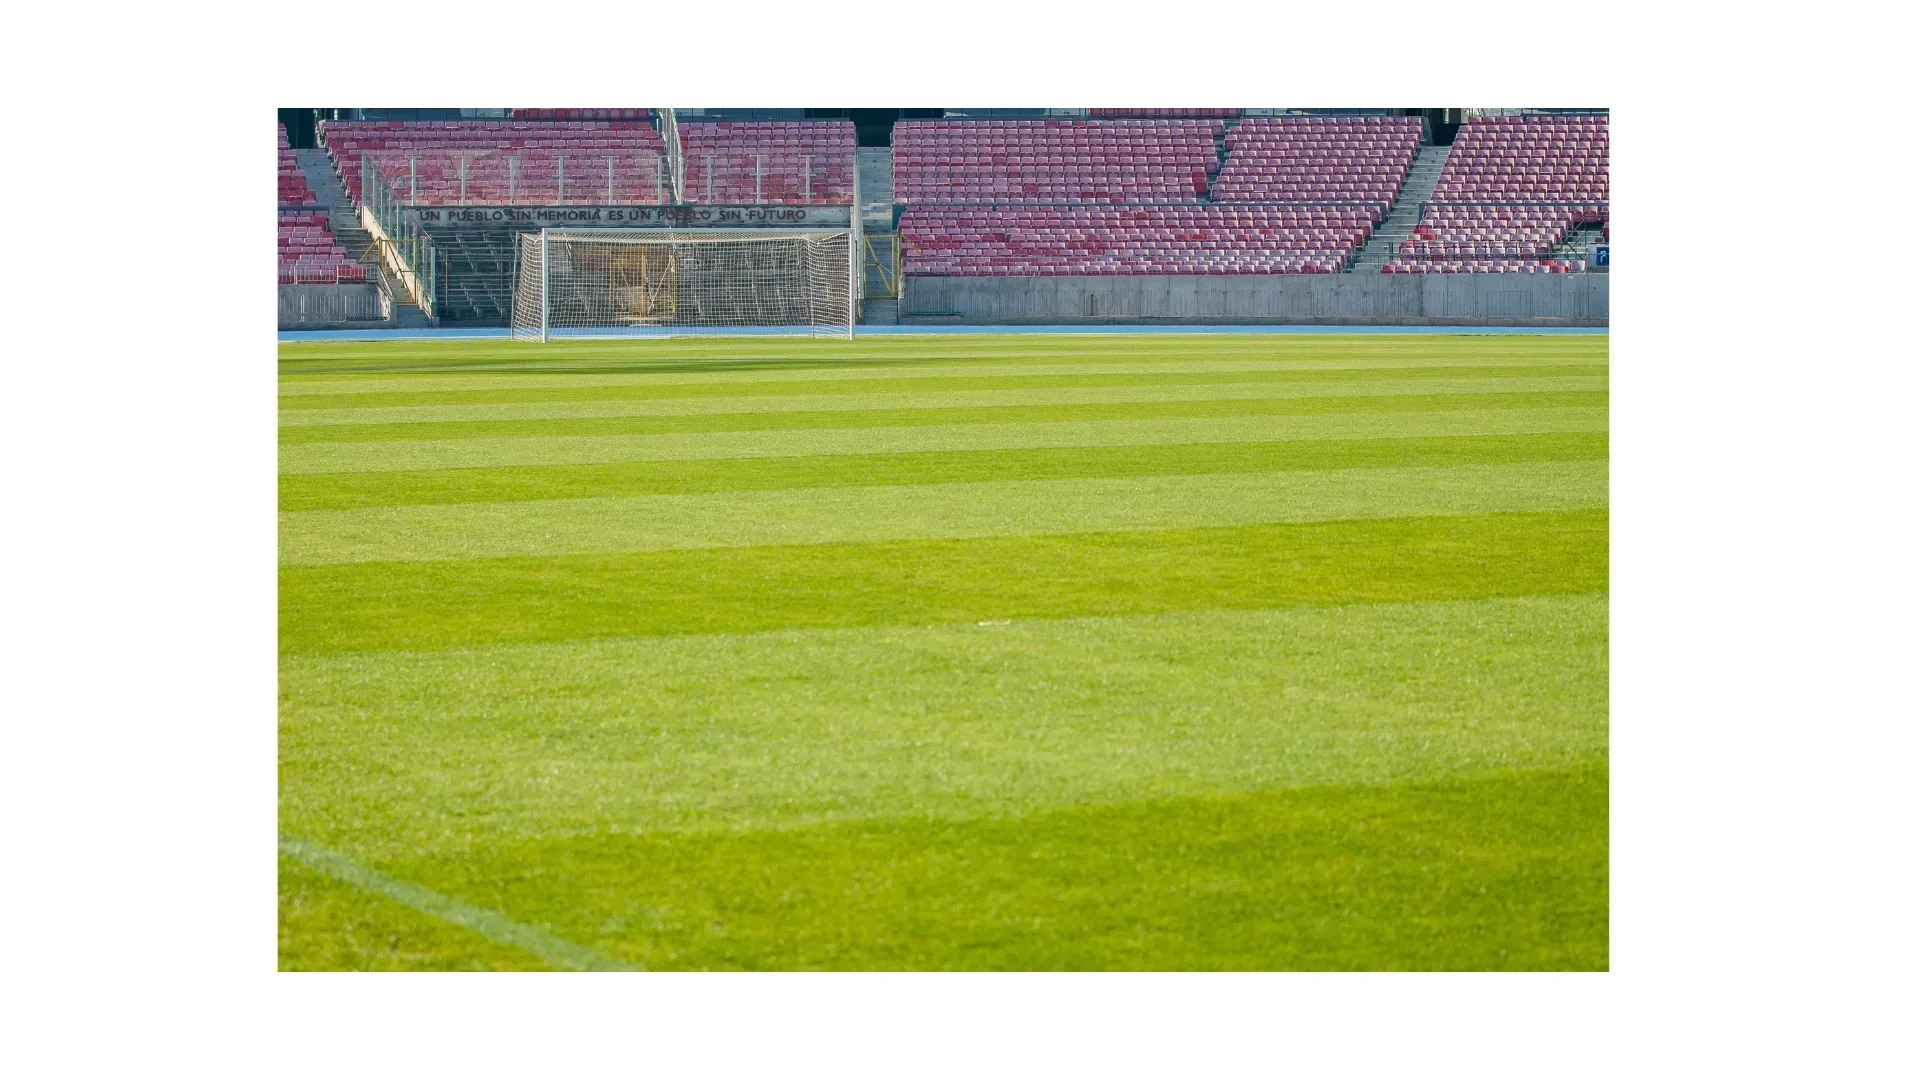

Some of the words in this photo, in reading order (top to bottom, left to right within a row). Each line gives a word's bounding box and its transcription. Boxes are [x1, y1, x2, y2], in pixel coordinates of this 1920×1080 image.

[419, 211, 440, 221] UN
[448, 211, 503, 221] PUEBLO
[509, 211, 531, 221] SIN
[537, 210, 602, 221] MEMORIA
[608, 210, 624, 221] ES
[629, 210, 651, 221] UN
[718, 209, 741, 220] SIN
[748, 209, 807, 220] FUTURO
